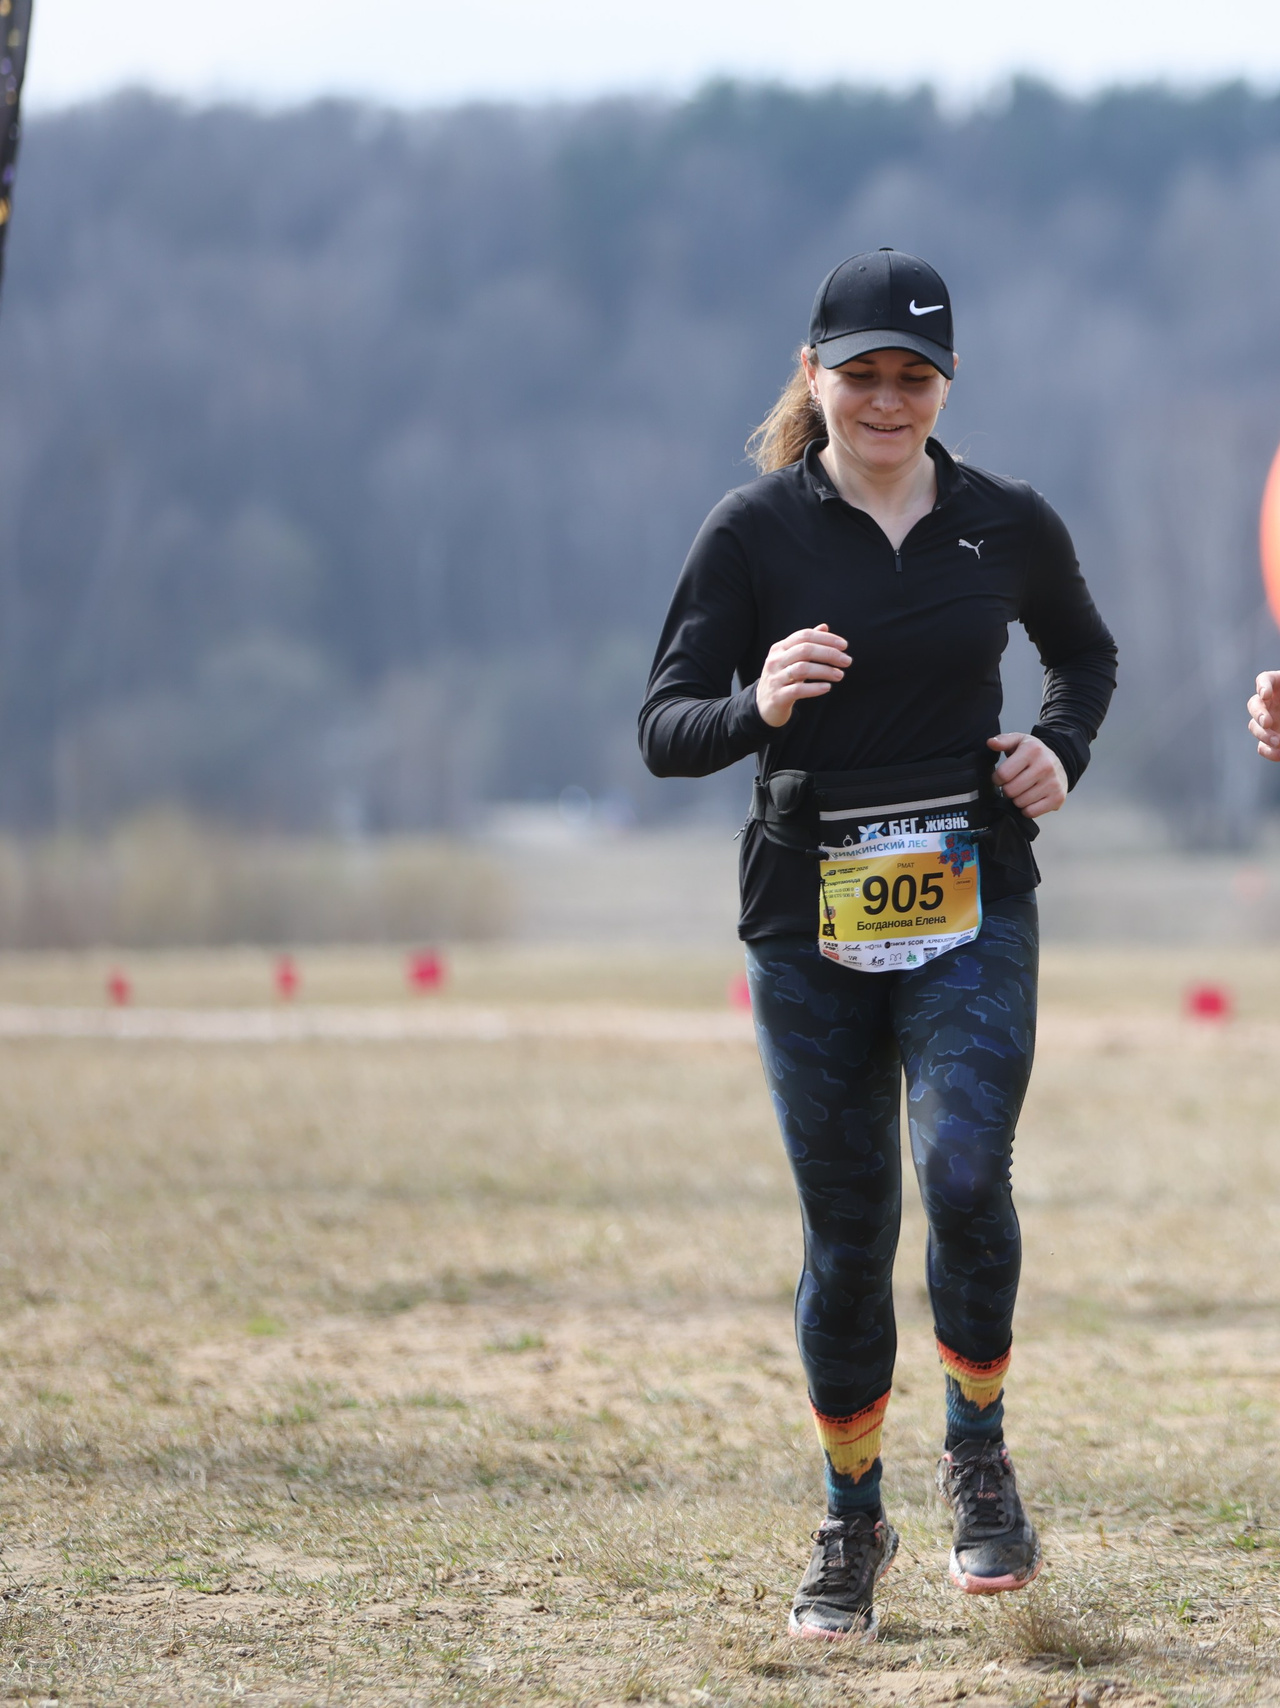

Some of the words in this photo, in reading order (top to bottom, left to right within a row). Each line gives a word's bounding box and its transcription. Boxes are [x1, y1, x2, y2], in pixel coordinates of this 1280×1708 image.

[925, 817, 969, 832] ЖИЗНЬ
[907, 839, 928, 849] ЛЕС
[862, 872, 944, 916] 905
[856, 917, 913, 931] Богданова
[915, 915, 947, 926] Елена
